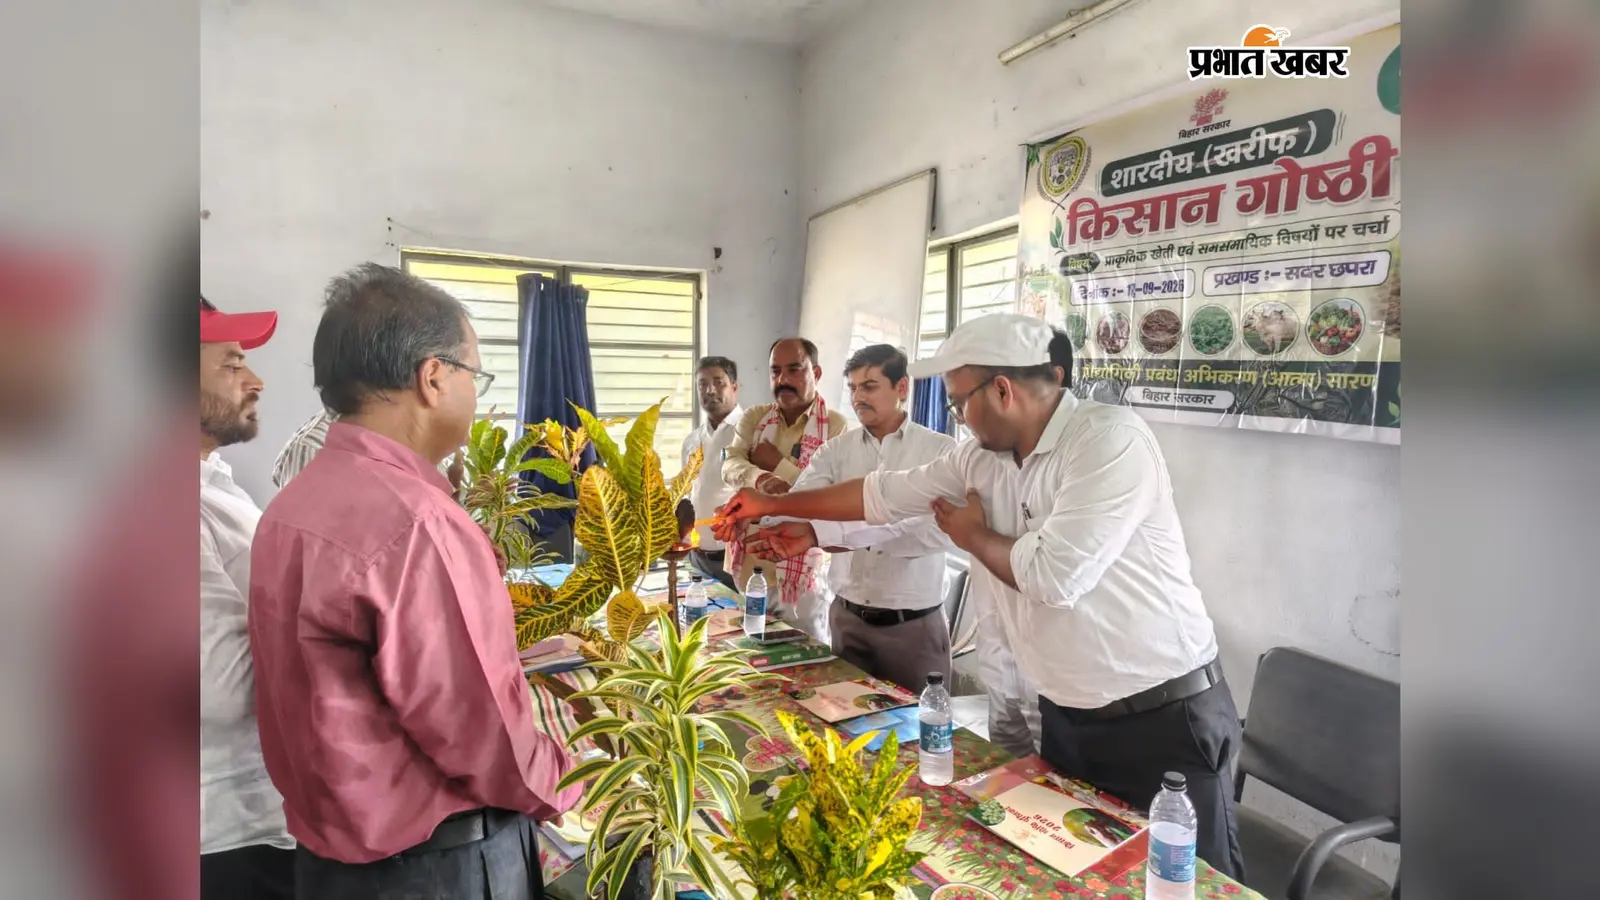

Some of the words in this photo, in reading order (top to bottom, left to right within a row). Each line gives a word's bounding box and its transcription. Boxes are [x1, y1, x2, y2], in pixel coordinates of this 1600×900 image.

[1179, 128, 1201, 139] बिहार
[1202, 120, 1231, 133] सरकार
[1110, 149, 1195, 189] शारदीय
[1066, 184, 1227, 246] किसान
[1236, 135, 1398, 216] गोष्ठी
[1105, 249, 1148, 269] प्राकृतिक
[1150, 244, 1174, 260] खेती
[1177, 241, 1196, 256] एवं
[1277, 224, 1319, 246] विषयों
[1325, 225, 1348, 240] पर
[1352, 215, 1390, 236] चर्चा
[1214, 269, 1261, 288] प्रखण्ड
[1285, 264, 1327, 282] सदर
[1329, 260, 1378, 277] छपरा
[1145, 365, 1178, 382] प्रबंध
[1183, 364, 1258, 386] अभिकरण
[1326, 373, 1378, 390] सारण
[1143, 388, 1171, 402] बिहार
[1174, 393, 1217, 405] सरकार
